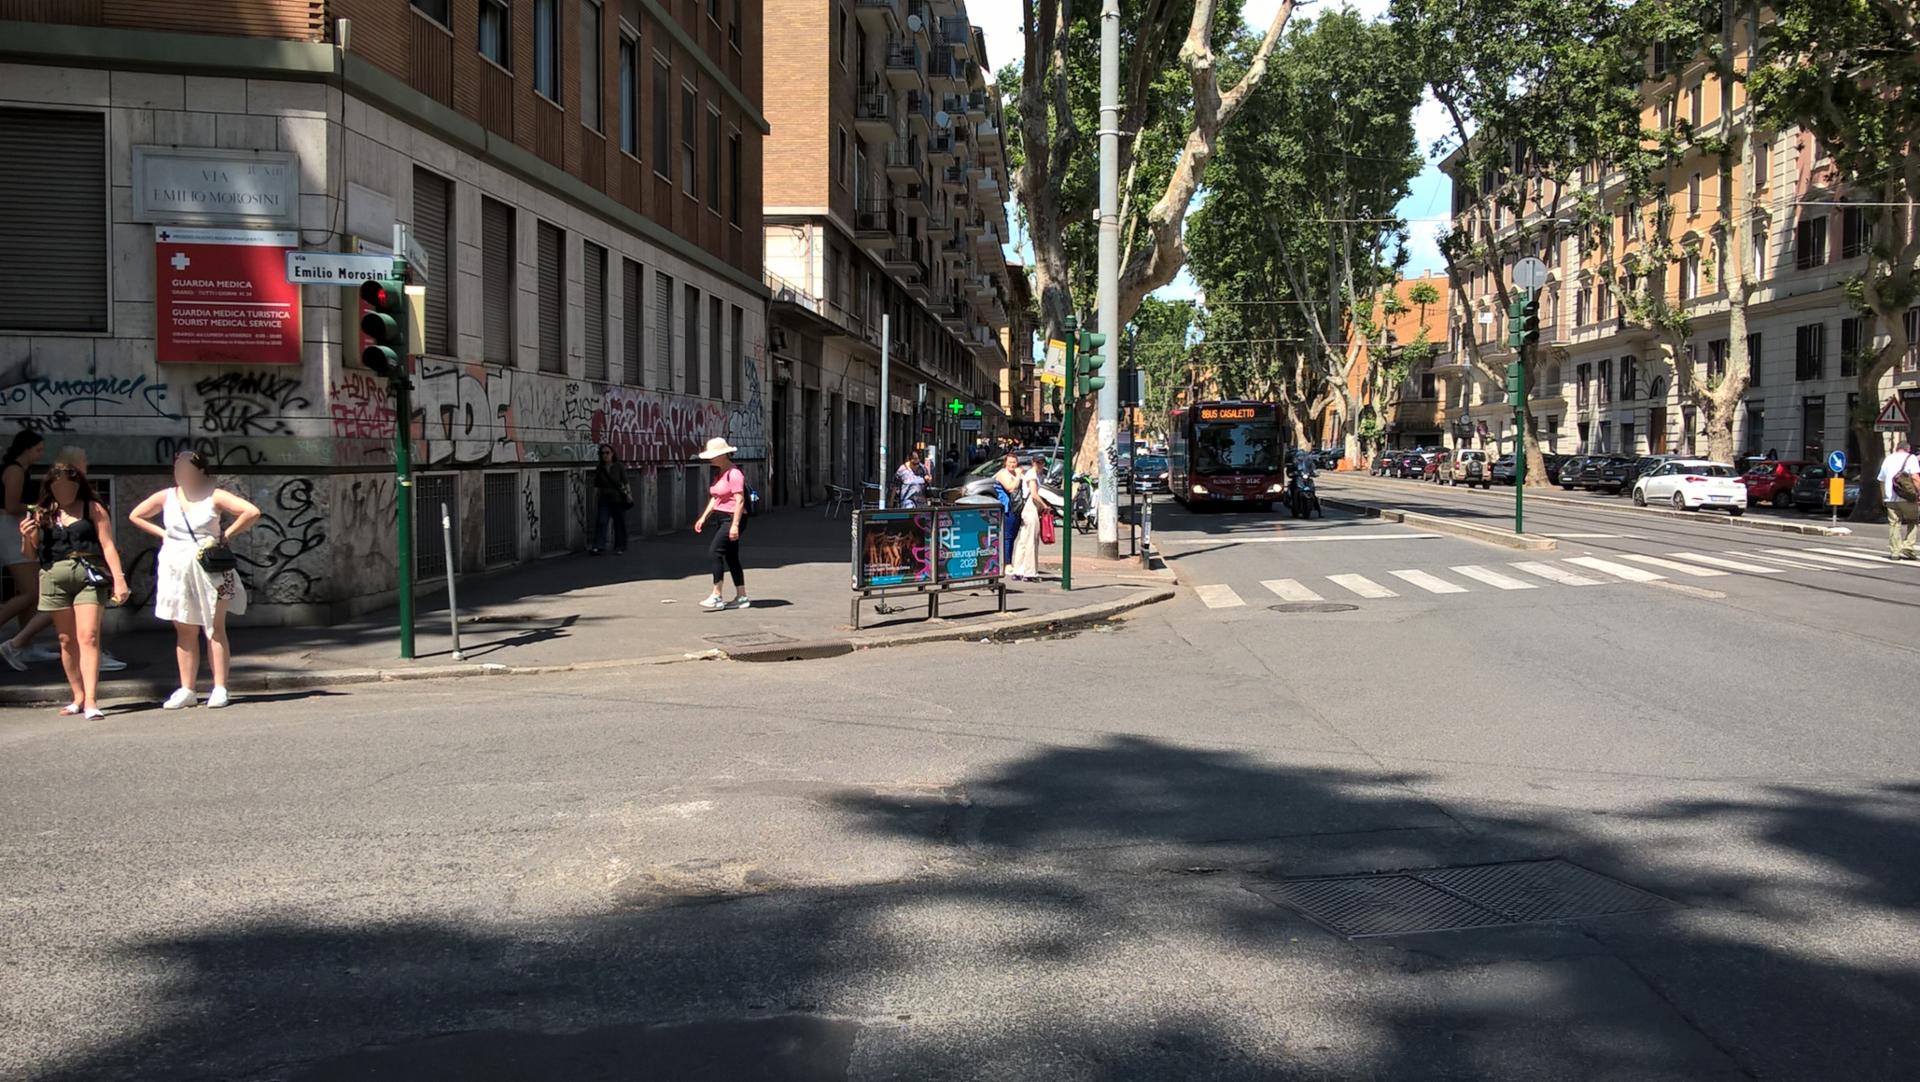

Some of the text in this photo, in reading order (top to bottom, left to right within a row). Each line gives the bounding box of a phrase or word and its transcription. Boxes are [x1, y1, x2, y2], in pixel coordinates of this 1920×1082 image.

[202, 169, 228, 182] VIA
[153, 188, 279, 206] EMILIO MOROSINI
[295, 266, 387, 281] Emilio Morosini
[171, 279, 215, 287] GUARDIA
[248, 311, 290, 319] TURISTICA
[172, 318, 209, 326] TOURIST
[1220, 408, 1255, 418] CASALETTO
[939, 527, 961, 549] RE
[960, 558, 977, 569] 2023
